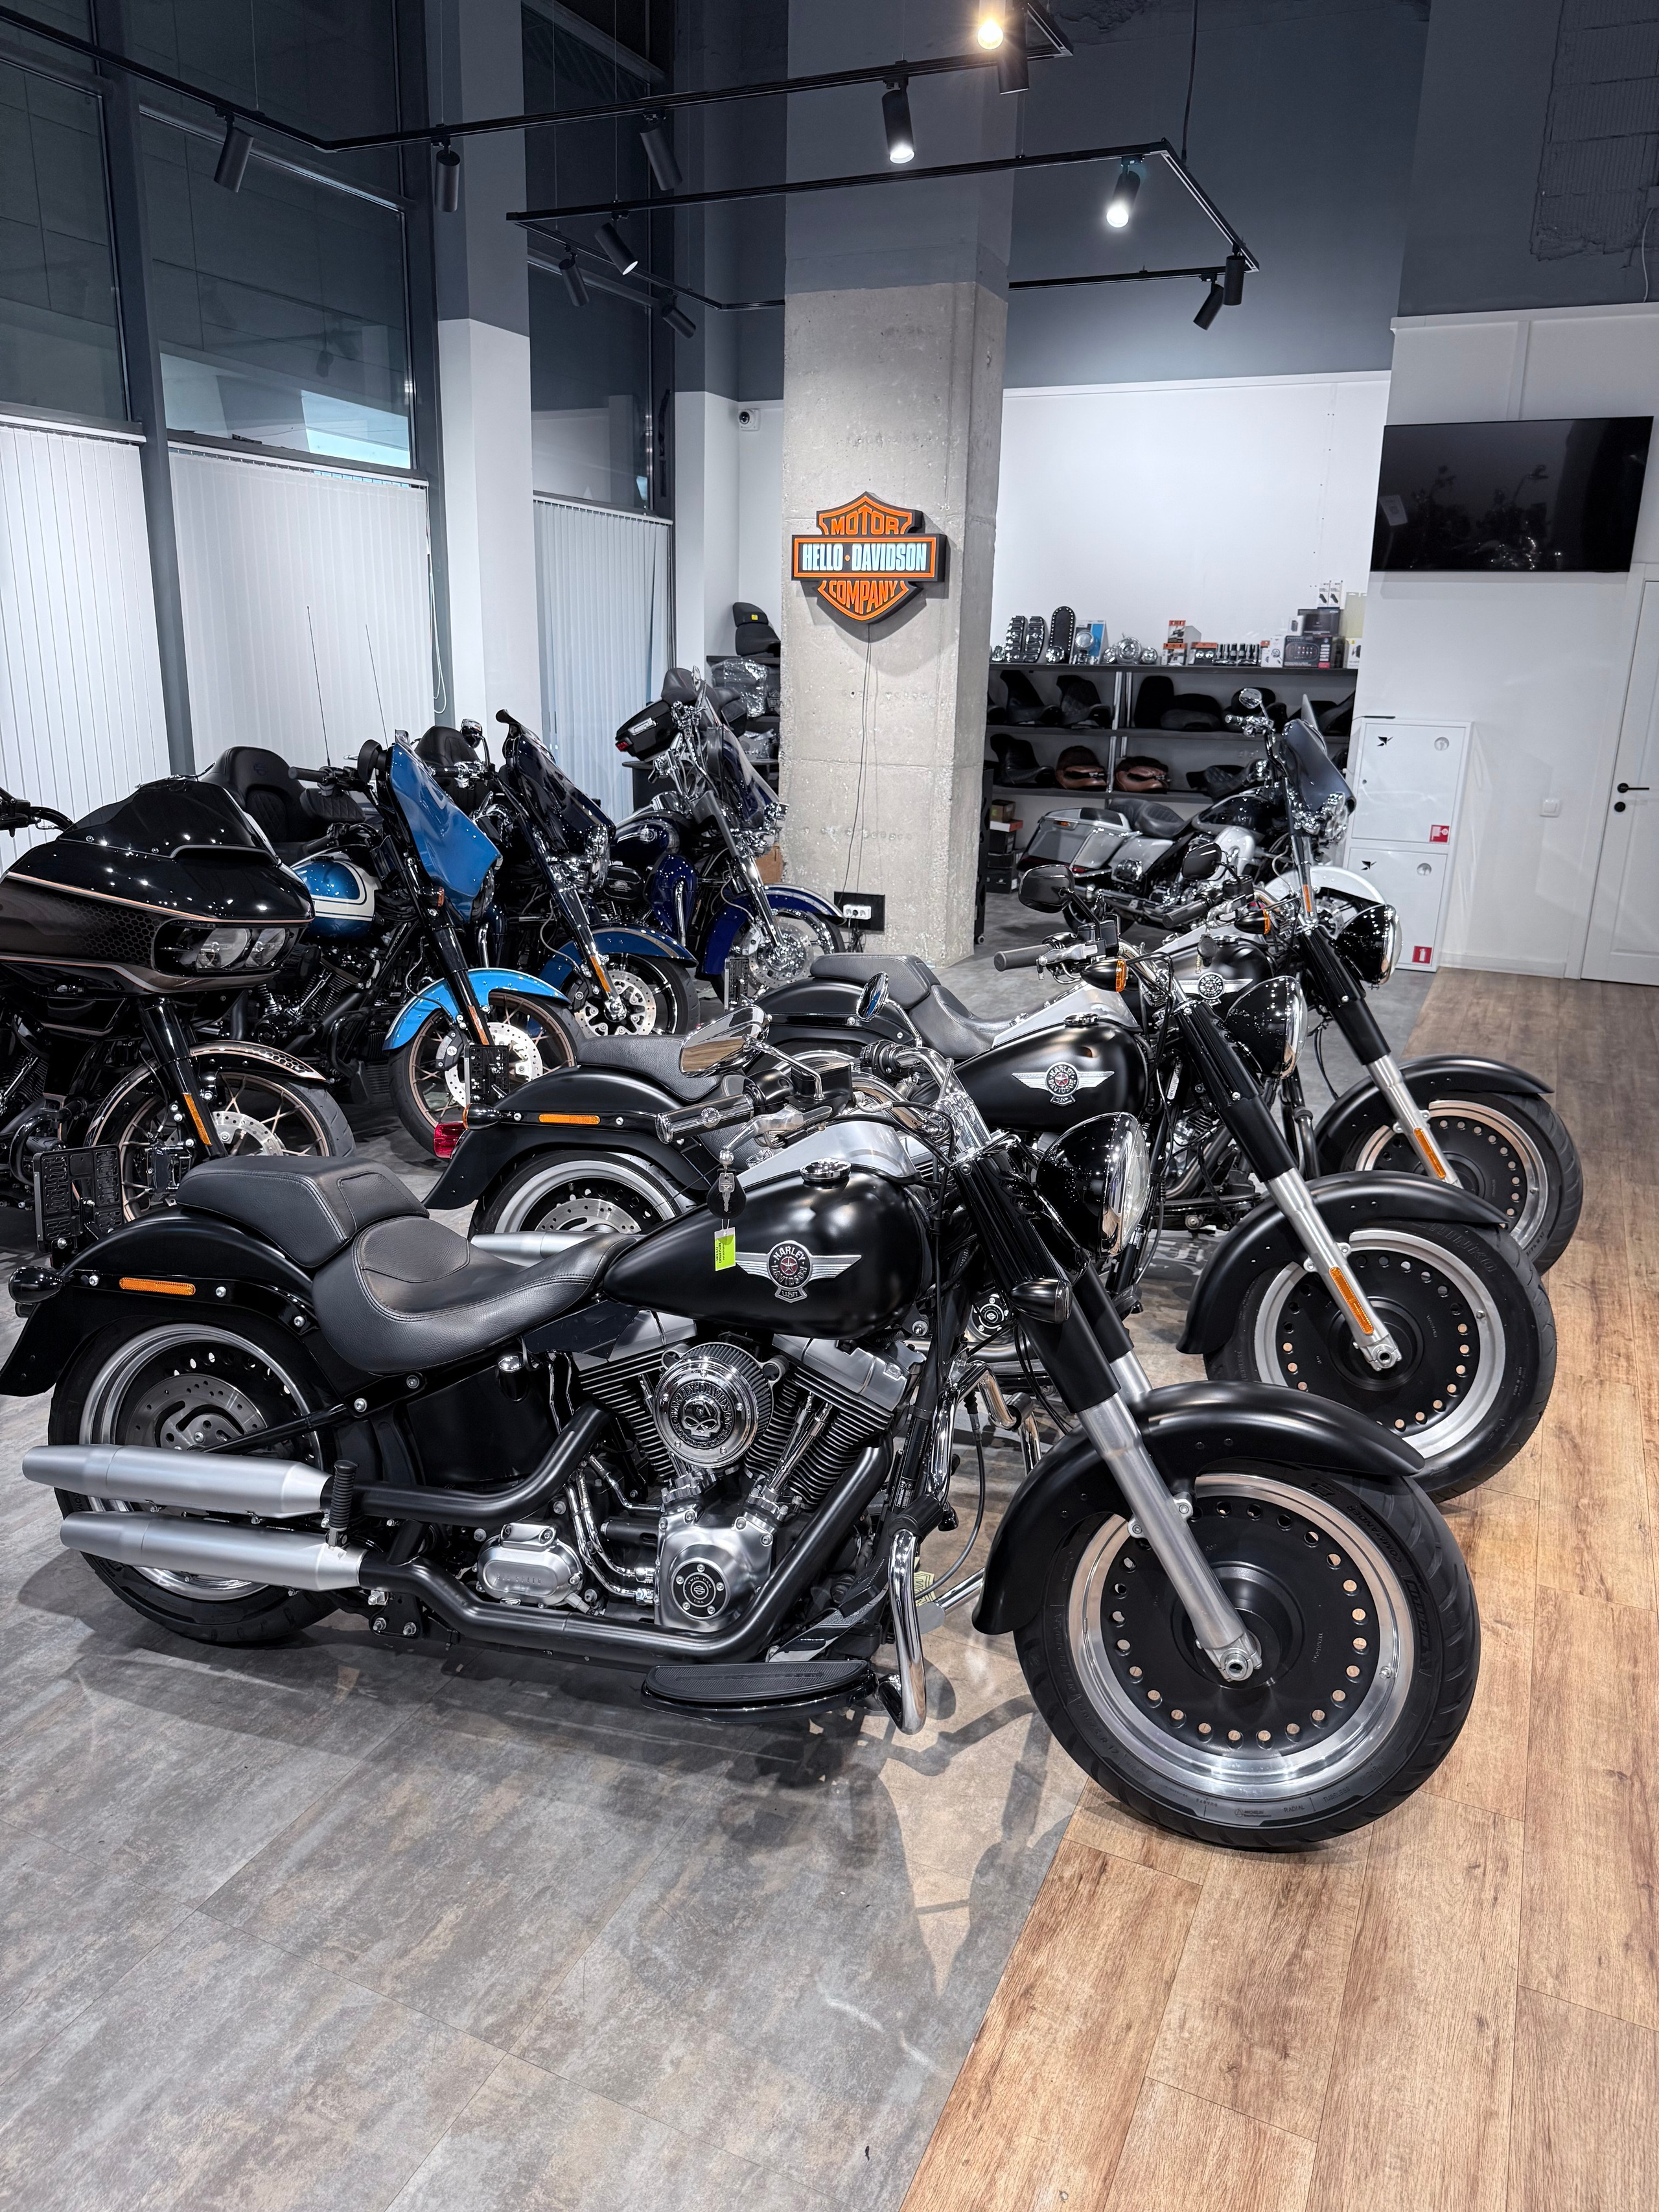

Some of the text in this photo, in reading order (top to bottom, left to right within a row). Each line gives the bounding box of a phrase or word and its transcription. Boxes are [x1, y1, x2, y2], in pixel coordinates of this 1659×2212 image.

[831, 505, 899, 535] MOTOR
[802, 543, 927, 571] HELLO DAVIDSON
[829, 580, 898, 614] COMPANY
[773, 1246, 806, 1261] HARLEY
[771, 1264, 808, 1286] DAVIDSON
[1347, 1505, 1402, 1565] COMMANDER
[688, 1576, 700, 1585] TWIN
[1283, 1804, 1305, 1813] RADIAL
